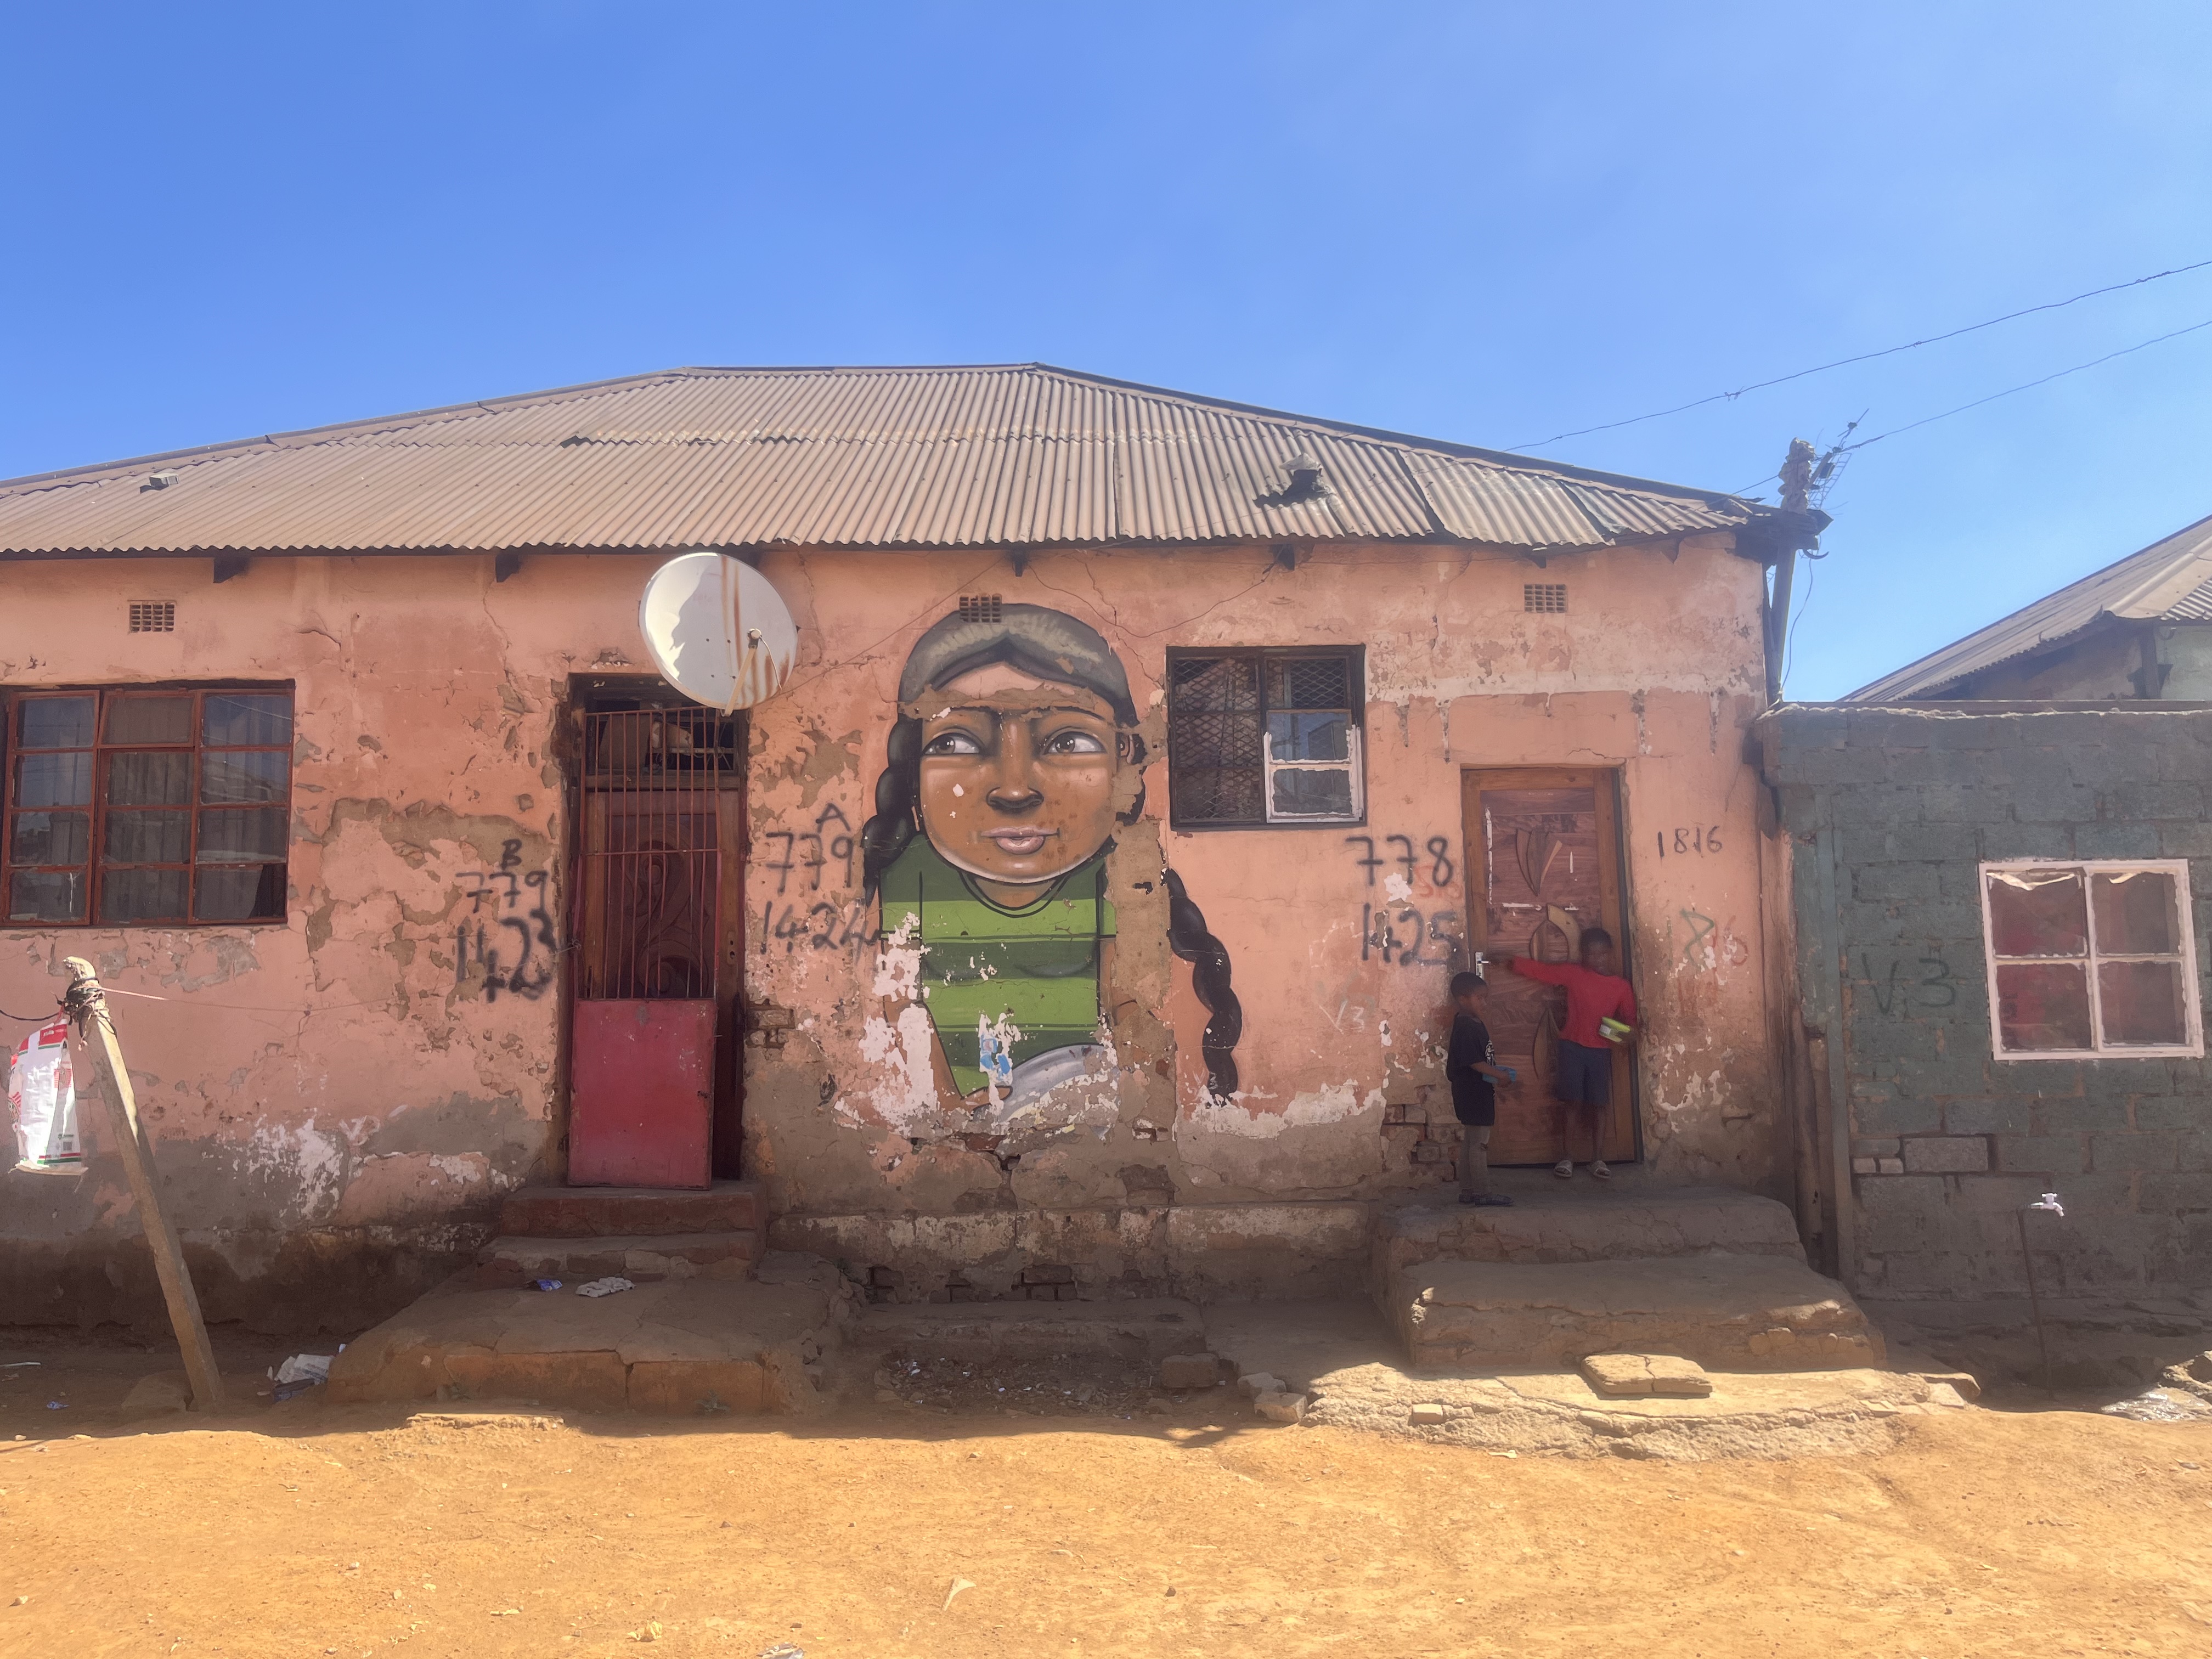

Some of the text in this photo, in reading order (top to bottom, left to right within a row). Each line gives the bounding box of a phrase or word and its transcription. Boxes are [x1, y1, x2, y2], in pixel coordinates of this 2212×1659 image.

[816, 802, 850, 833] A
[501, 839, 522, 870] B
[766, 831, 853, 895] 779
[1345, 834, 1454, 887] 778
[1657, 825, 1723, 859] 1816
[455, 871, 549, 913] 779
[760, 900, 878, 964] 1424
[1362, 902, 1464, 967] 1425
